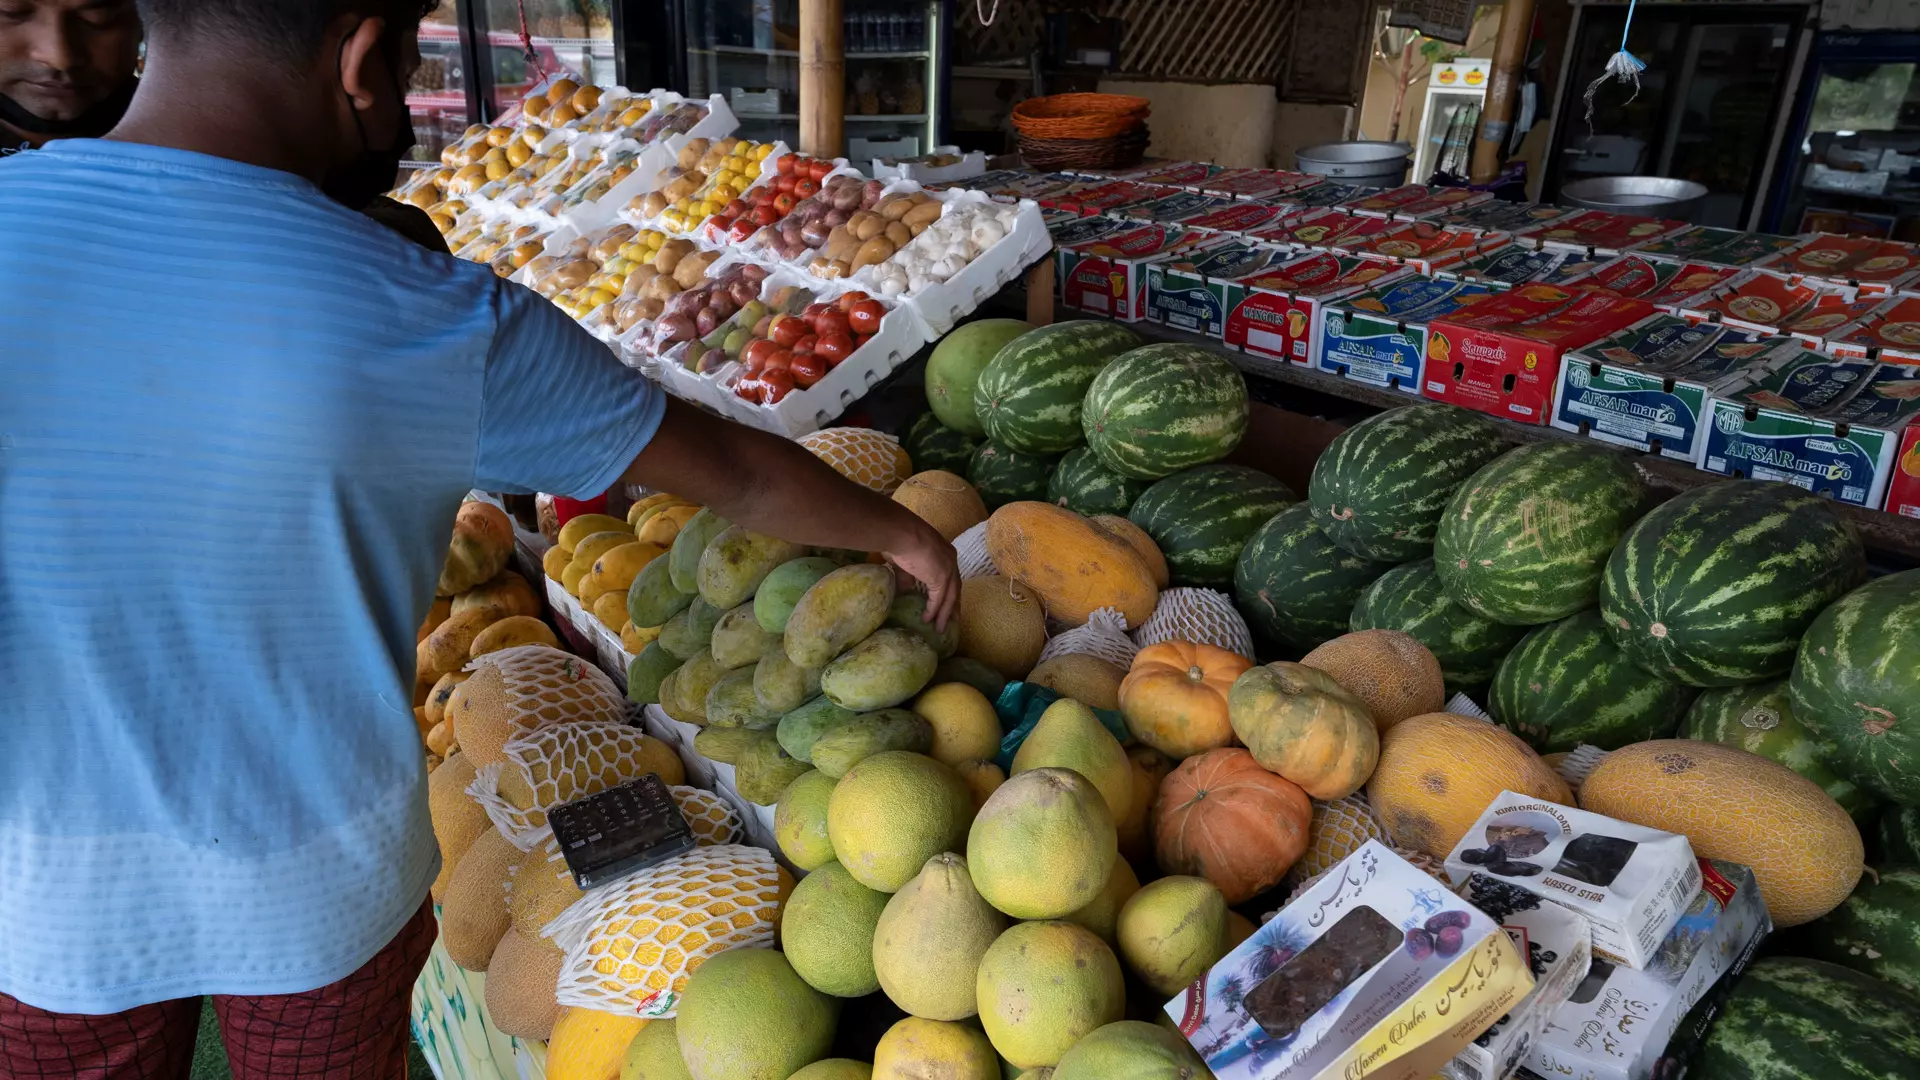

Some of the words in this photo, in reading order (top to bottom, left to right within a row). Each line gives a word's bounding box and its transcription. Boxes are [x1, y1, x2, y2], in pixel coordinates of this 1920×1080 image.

[1156, 294, 1187, 310] AFSAR
[1242, 305, 1284, 326] MANGOES
[1338, 341, 1375, 358] AFSAR
[1376, 349, 1404, 364] mango
[1461, 338, 1507, 362] Souvenir
[1467, 379, 1491, 389] MANGO
[1570, 369, 1588, 386] MAA
[1579, 391, 1630, 414] AFSAR
[1630, 403, 1676, 423] mango
[1718, 411, 1741, 430] MAA
[1807, 441, 1834, 452] PAKISTAN
[1725, 440, 1795, 469] AFSAR
[1796, 459, 1852, 481] mango
[1495, 806, 1517, 816] KIMI
[1518, 803, 1558, 818] ORGINAL
[1308, 864, 1362, 928] ياسين
[1578, 889, 1605, 904] STAR
[1436, 948, 1486, 1016] ياسين
[1344, 1043, 1388, 1080] Yaseen
[1389, 1001, 1427, 1047] Dates
